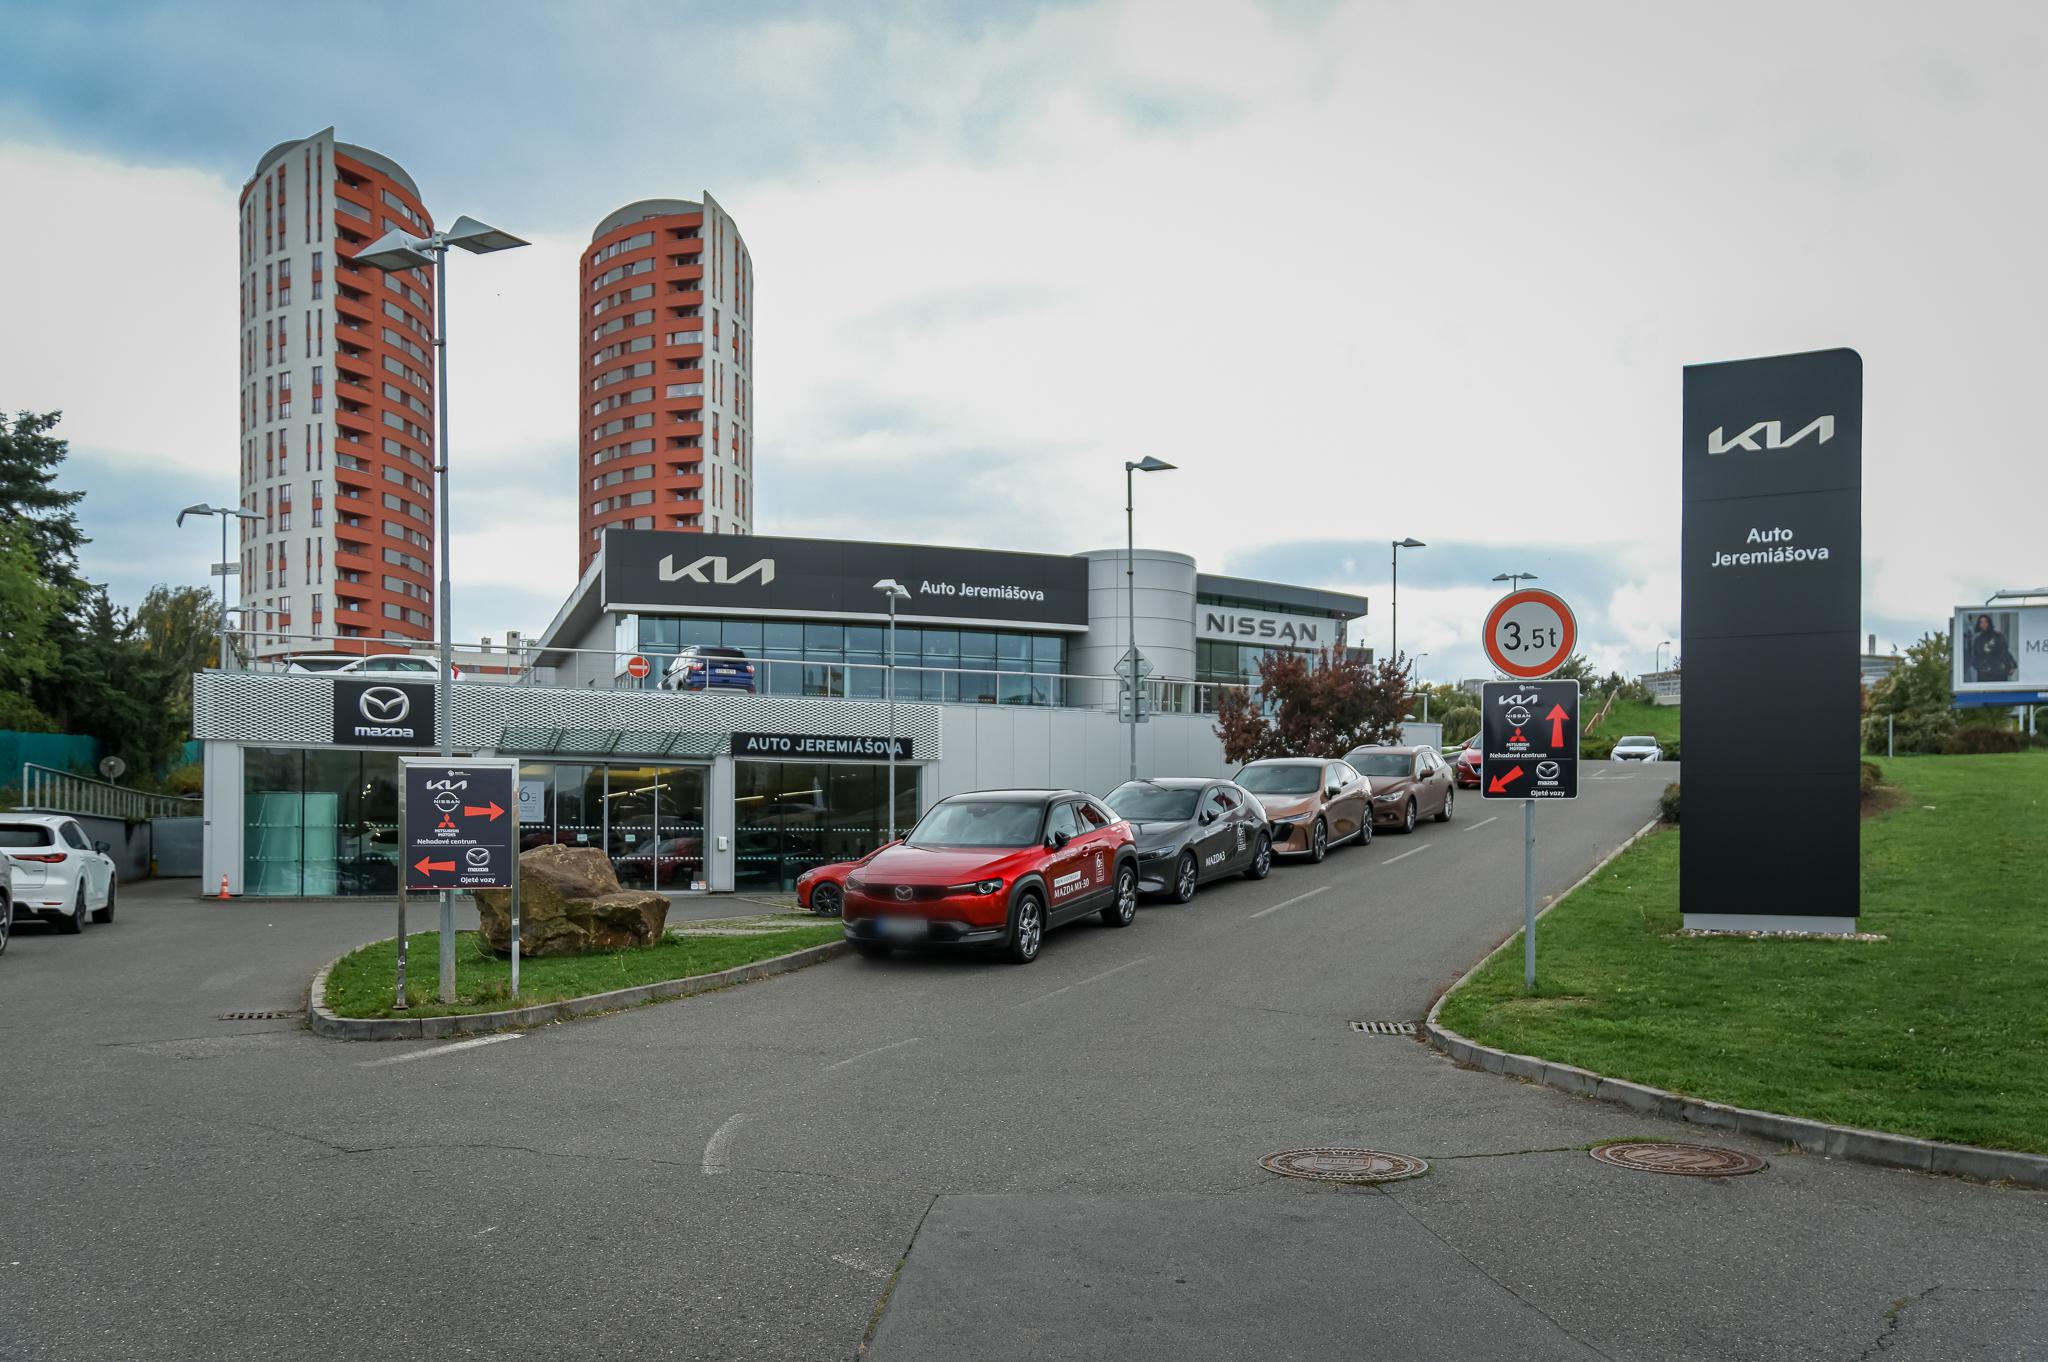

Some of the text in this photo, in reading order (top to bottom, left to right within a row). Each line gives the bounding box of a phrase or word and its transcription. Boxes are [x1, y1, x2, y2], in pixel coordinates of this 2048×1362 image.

[1708, 415, 1835, 455] KIA
[1746, 527, 1793, 543] Auto
[1711, 546, 1830, 567] Jeremiášova
[659, 554, 775, 586] KIA
[920, 580, 1044, 601] Auto Jeremiášova
[1206, 612, 1317, 642] NISSAN
[747, 737, 903, 754] AUTO JEREMIÁŠOVA
[519, 785, 530, 803] 6
[1205, 850, 1226, 868] MAZDA3
[460, 876, 479, 884] Ojeté
[1054, 884, 1074, 899] MAZDA
[1074, 877, 1090, 891] MX-30
